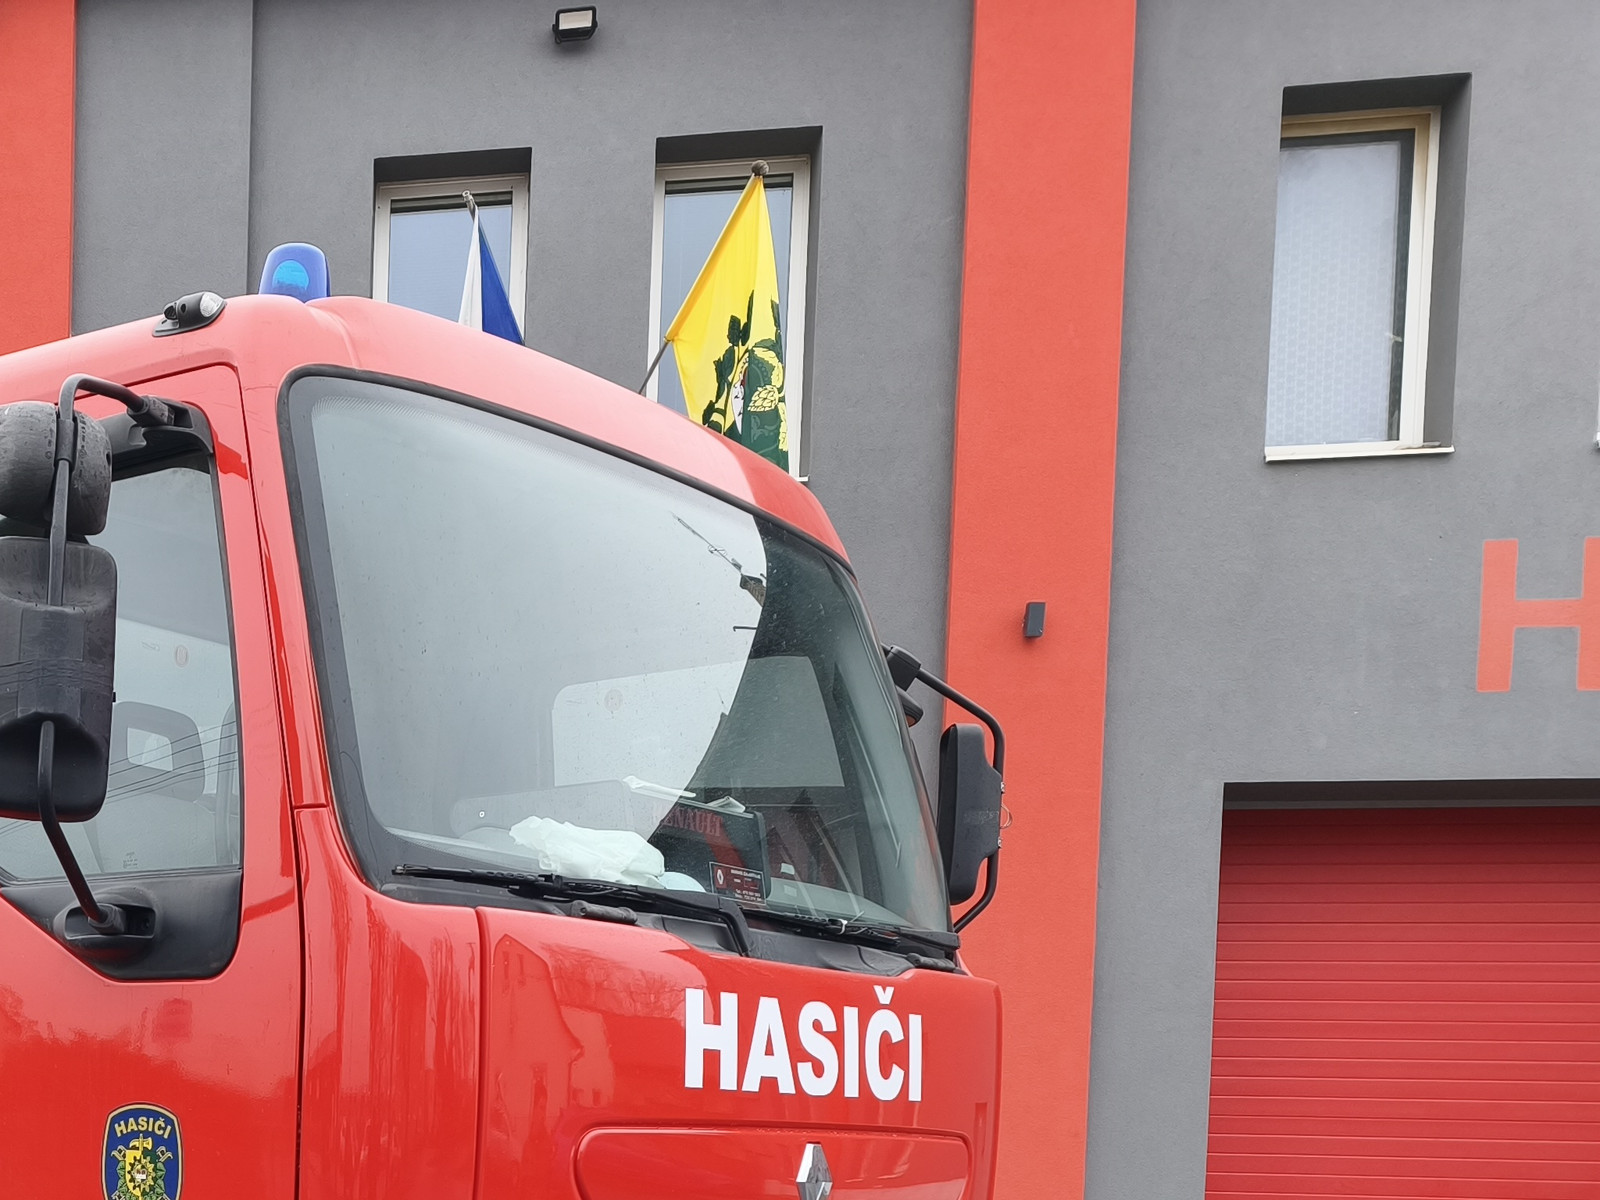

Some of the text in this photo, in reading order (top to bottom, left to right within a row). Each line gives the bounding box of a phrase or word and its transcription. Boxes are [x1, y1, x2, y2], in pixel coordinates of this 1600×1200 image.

[1476, 536, 1600, 692] H
[684, 985, 923, 1102] HASIČI
[114, 1116, 172, 1139] HASIČI
